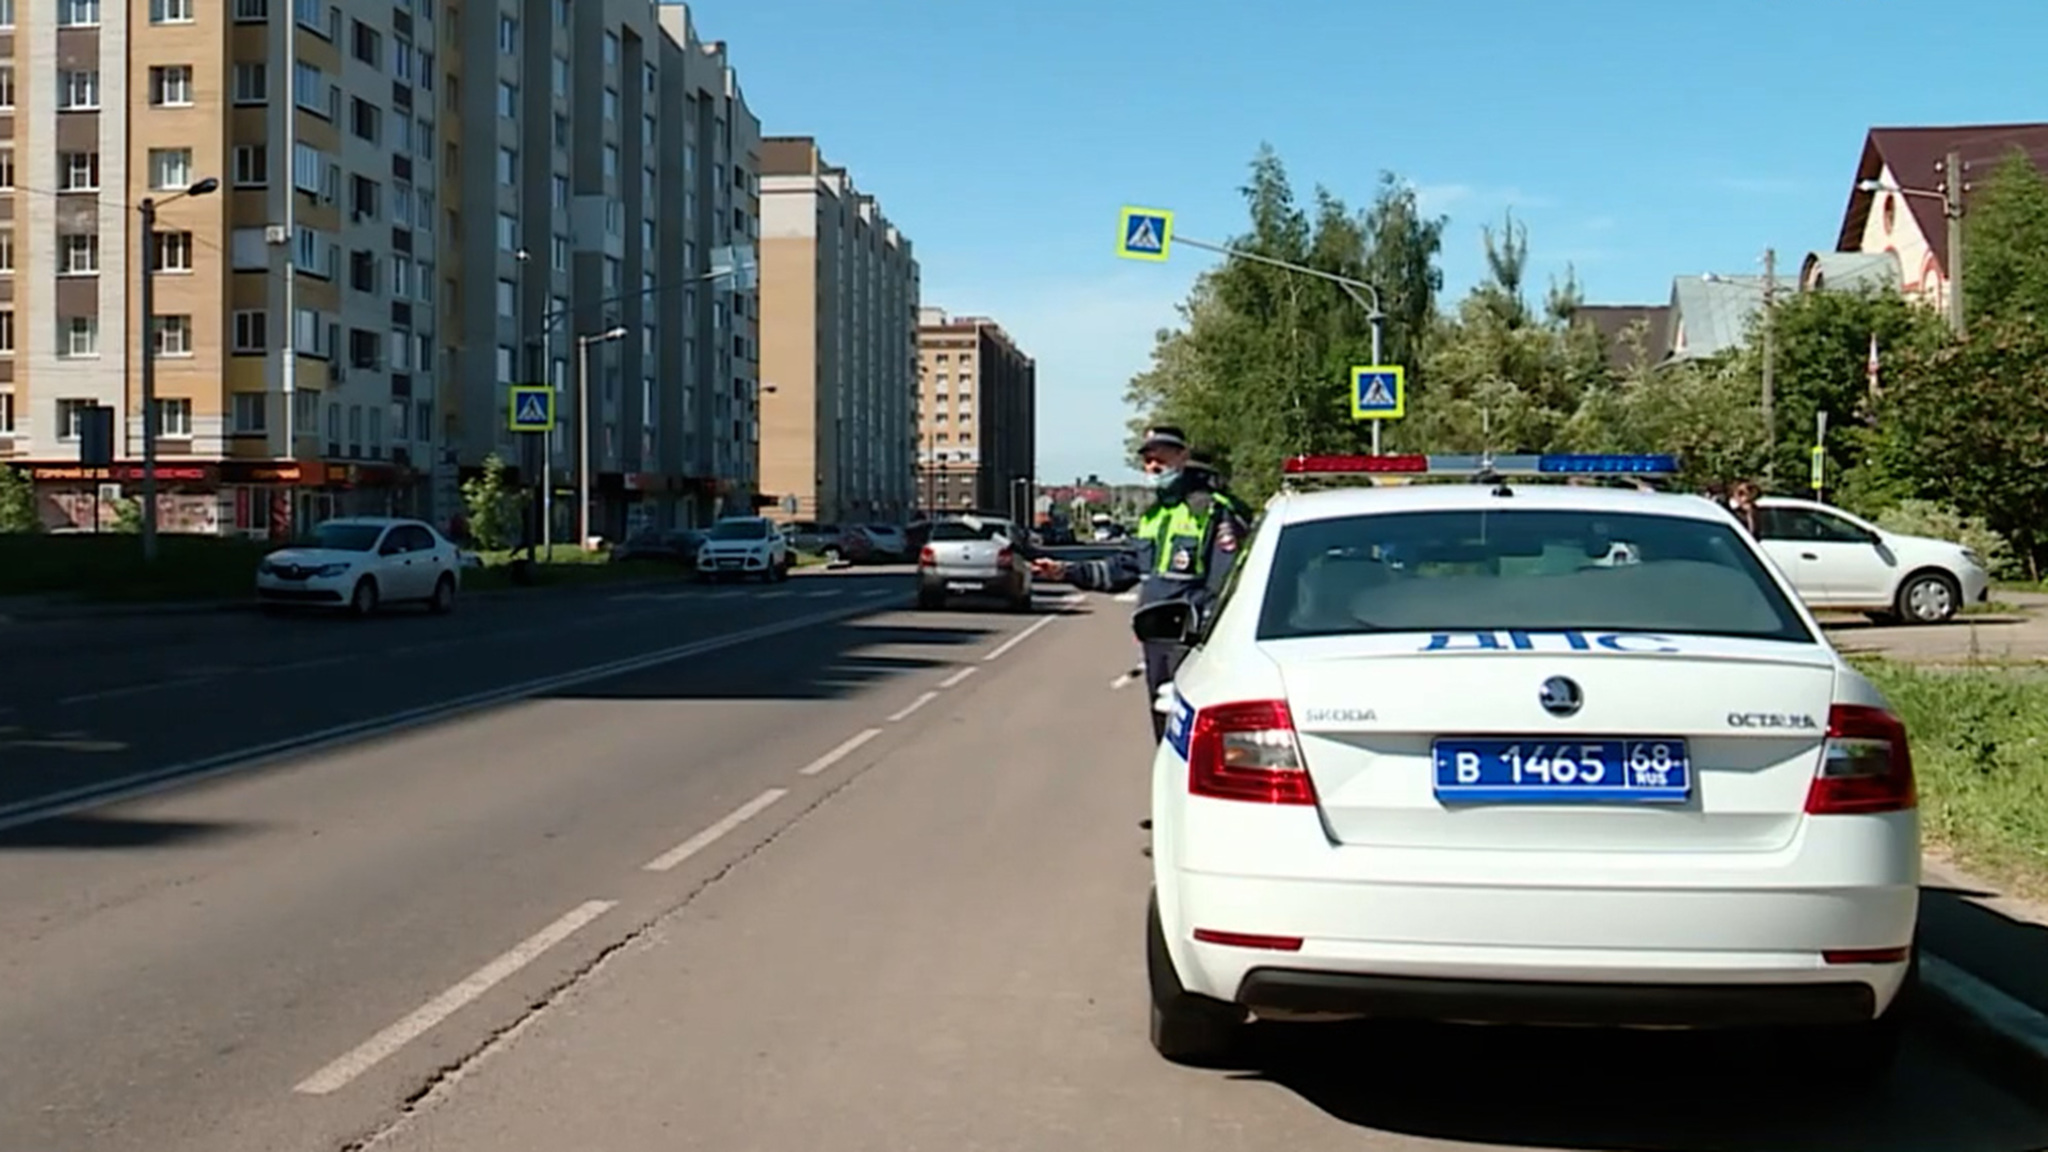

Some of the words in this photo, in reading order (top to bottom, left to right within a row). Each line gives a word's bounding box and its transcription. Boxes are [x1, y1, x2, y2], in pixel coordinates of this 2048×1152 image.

[1418, 630, 1679, 652] ДПС
[1500, 745, 1606, 783] 1465
[1631, 744, 1672, 772] 68
[1636, 772, 1668, 785] RUS
